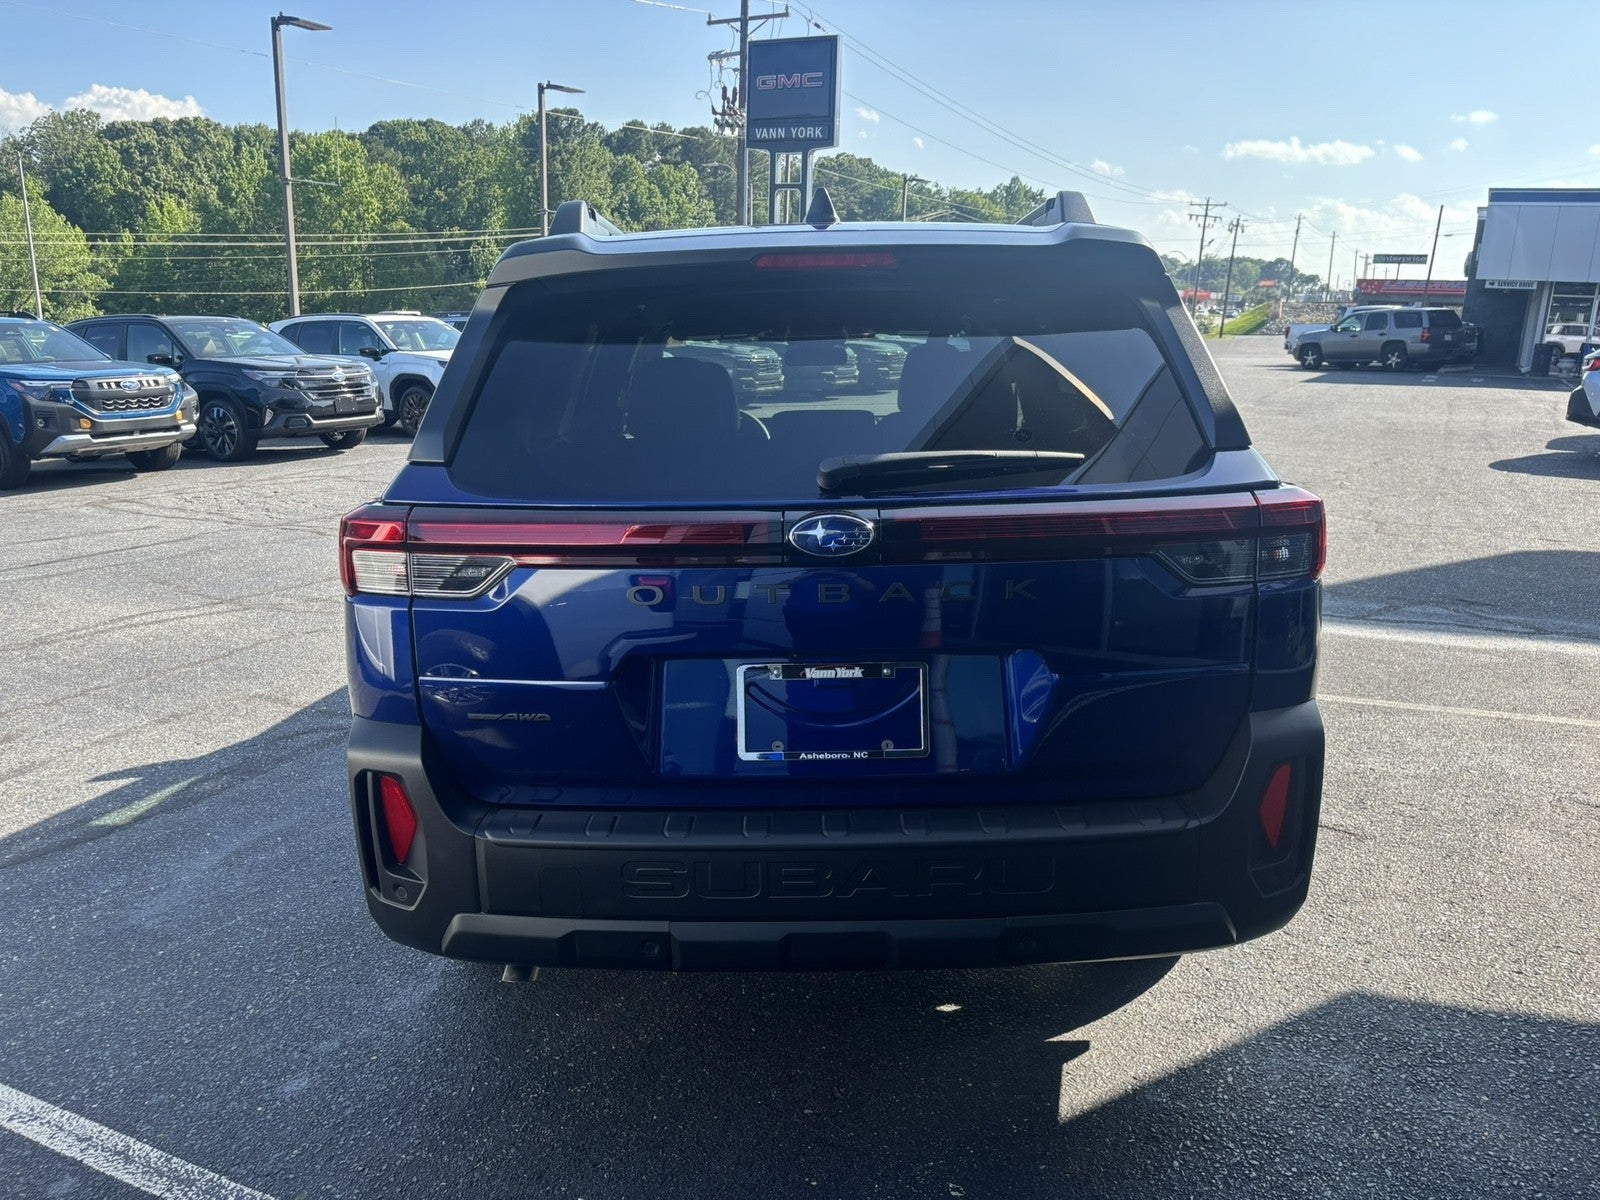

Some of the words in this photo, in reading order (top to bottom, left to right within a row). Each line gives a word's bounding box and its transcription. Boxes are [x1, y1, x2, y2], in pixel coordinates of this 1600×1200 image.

[756, 72, 823, 90] GMC
[755, 127, 785, 139] VANN
[790, 126, 823, 138] YORK
[1497, 280, 1519, 288] SERVICE
[626, 578, 1038, 606] OUTBACK
[805, 667, 836, 678] Vann
[835, 666, 864, 678] York
[499, 712, 551, 721] AWD
[853, 751, 868, 759] NC
[620, 856, 1056, 899] SUBARU
